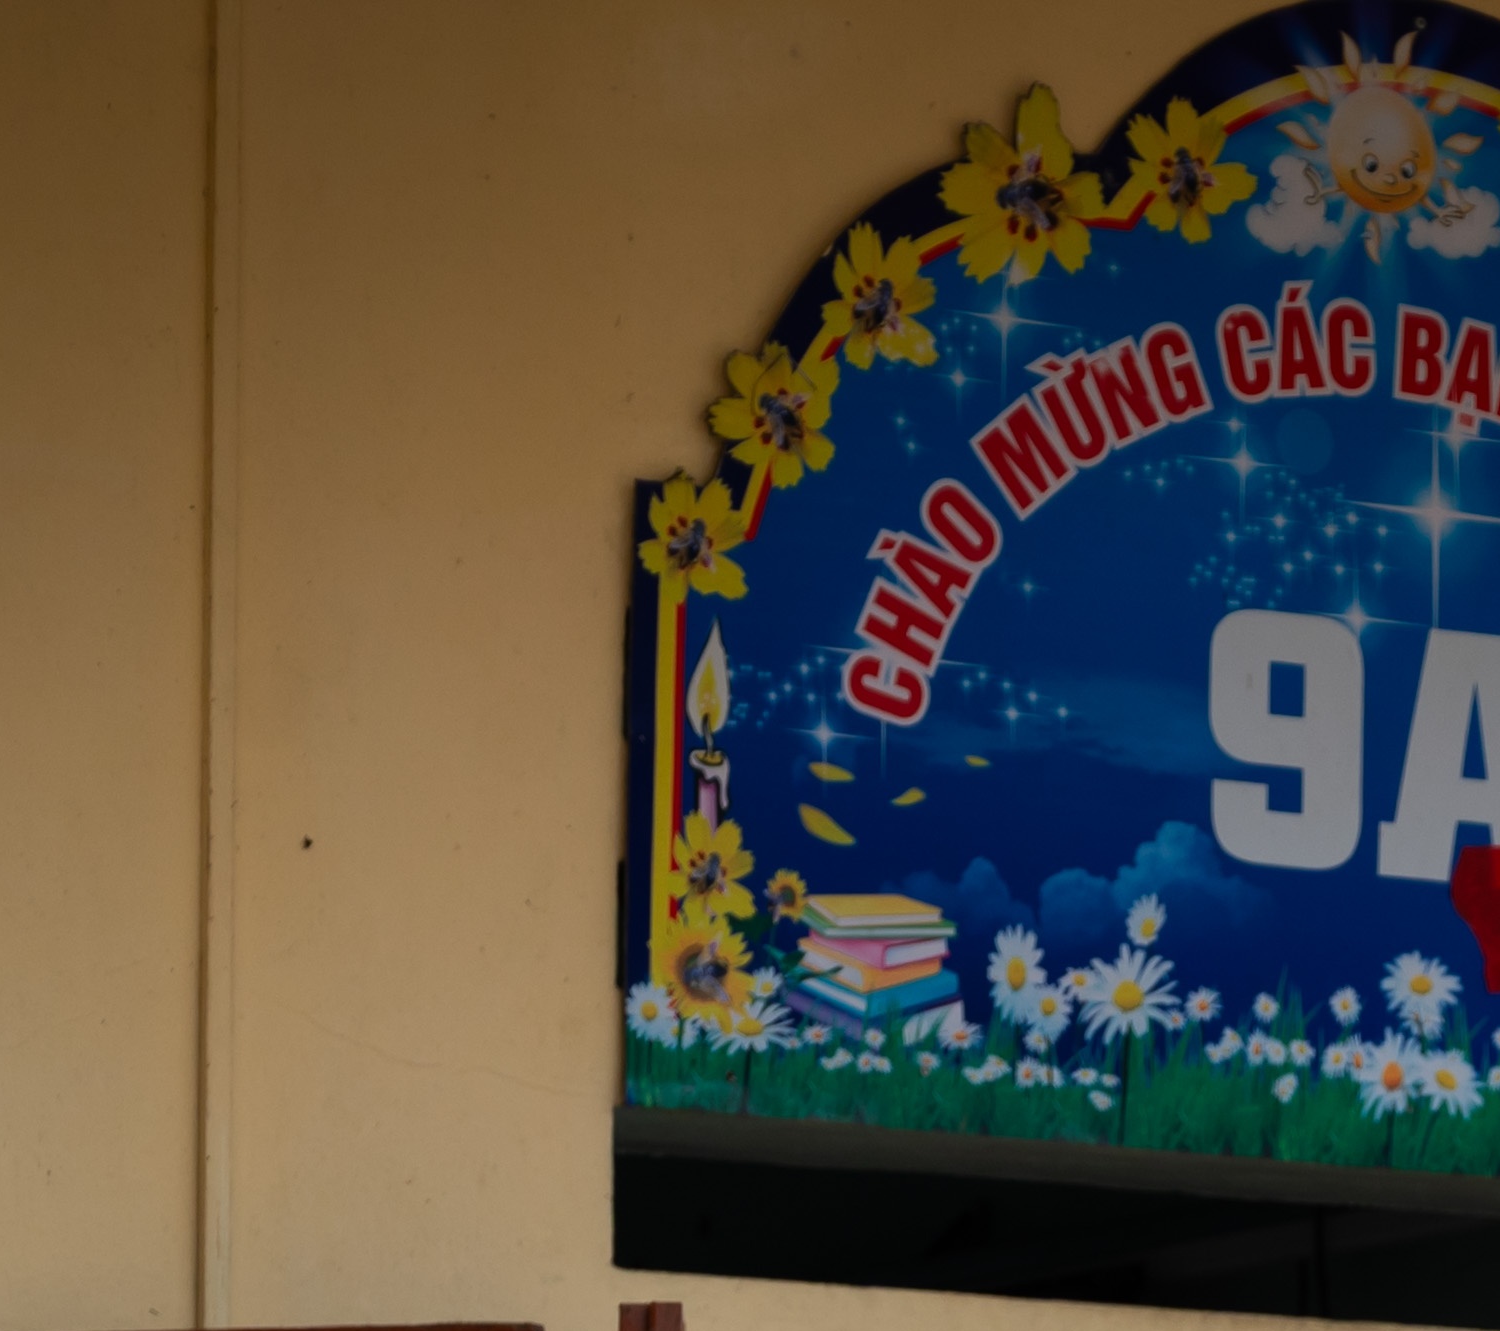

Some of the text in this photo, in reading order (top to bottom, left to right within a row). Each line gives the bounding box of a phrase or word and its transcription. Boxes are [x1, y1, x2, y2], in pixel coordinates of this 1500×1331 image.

[844, 480, 1001, 725] CHÀO
[975, 326, 1209, 515] MỪNG
[1218, 284, 1375, 401] CÁC
